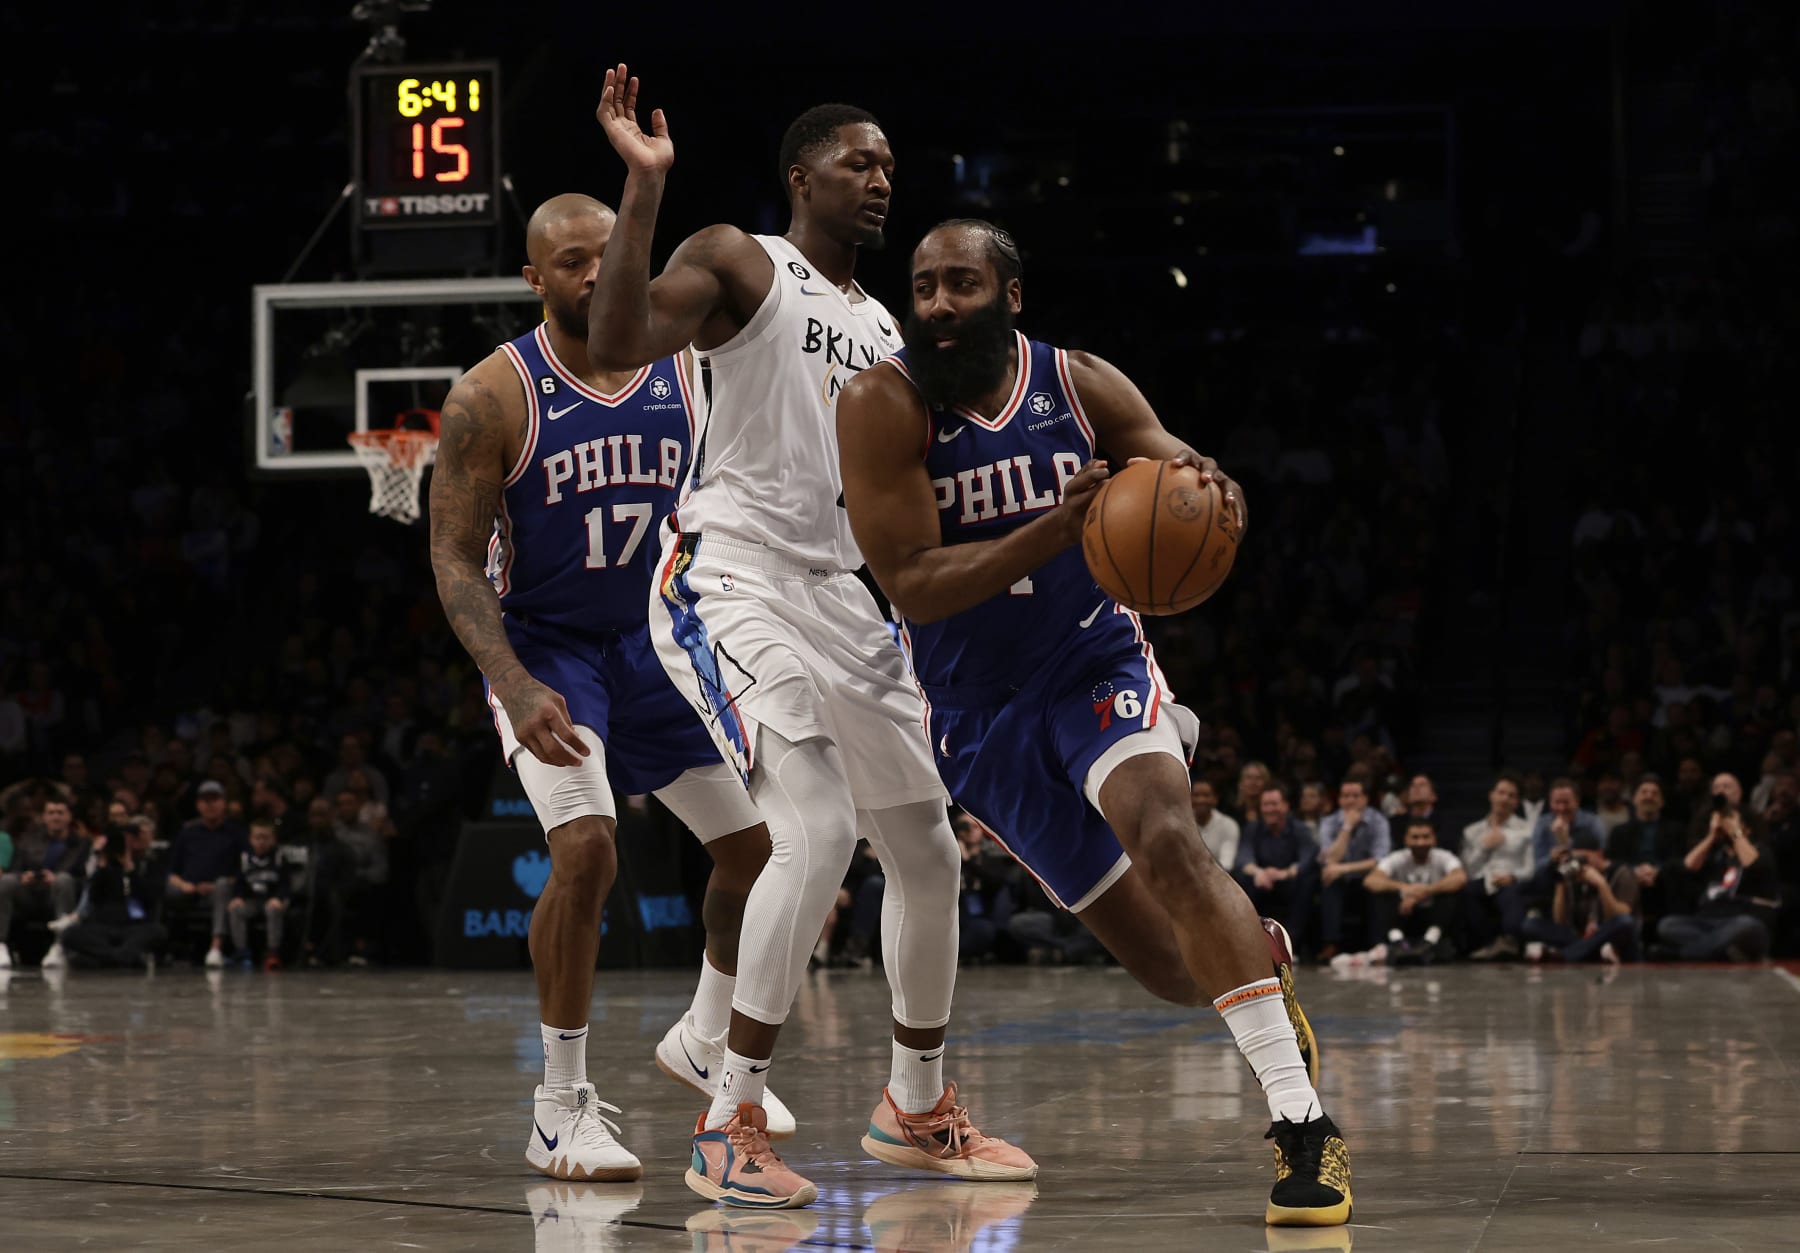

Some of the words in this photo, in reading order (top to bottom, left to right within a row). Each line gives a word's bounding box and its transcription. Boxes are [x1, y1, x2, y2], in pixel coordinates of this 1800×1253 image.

[398, 79, 480, 117] 6:41
[412, 117, 469, 182] 15
[401, 194, 489, 214] TISSOT
[540, 377, 556, 394] 6
[1028, 412, 1072, 431] crypto.com
[541, 434, 683, 505] PHILA
[584, 502, 653, 569] 17
[1092, 687, 1142, 733] 76
